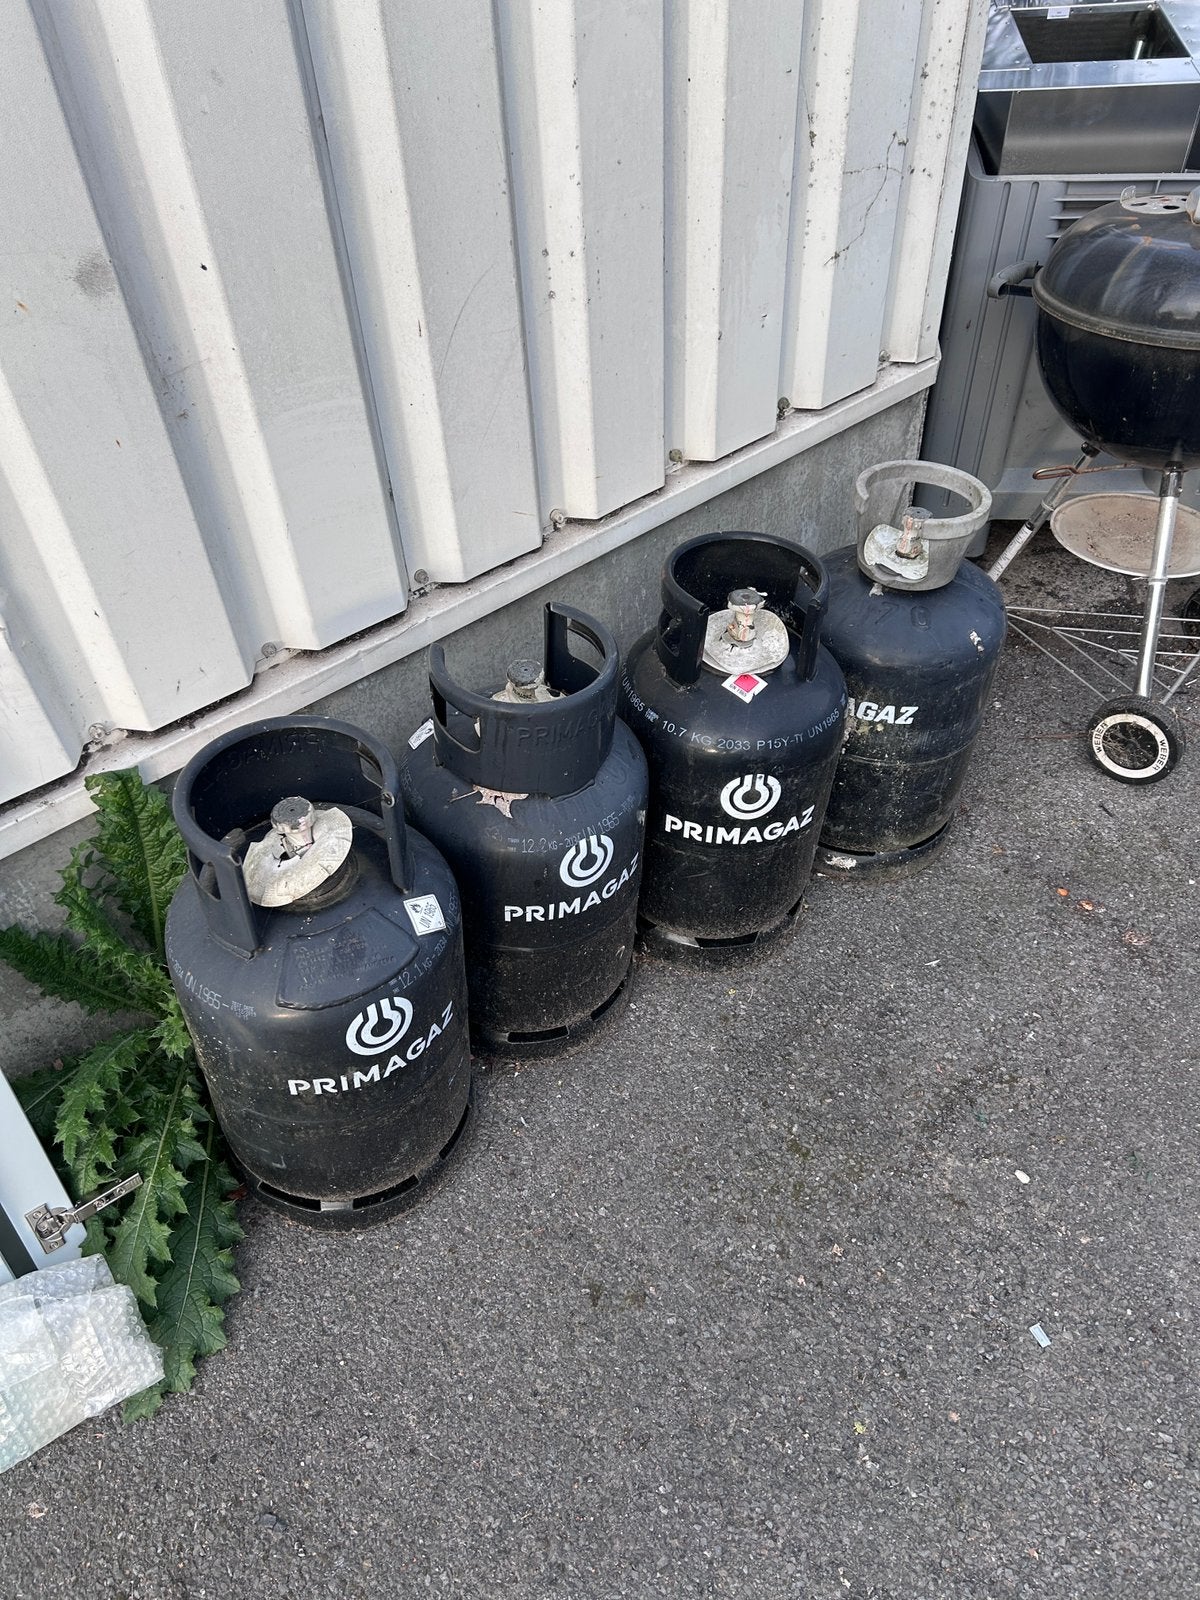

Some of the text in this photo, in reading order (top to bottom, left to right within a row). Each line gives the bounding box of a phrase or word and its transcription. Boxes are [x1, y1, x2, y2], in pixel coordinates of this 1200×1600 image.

[662, 720, 687, 737] 10.7
[691, 732, 712, 746] KG
[717, 738, 751, 751] 2033
[807, 707, 840, 738] UN1965
[1152, 738, 1169, 771] WEBER
[664, 804, 815, 845] PRIMAGAZ
[504, 852, 639, 922] PRIMAGAZ
[287, 1000, 453, 1096] PRIMAGAZ
